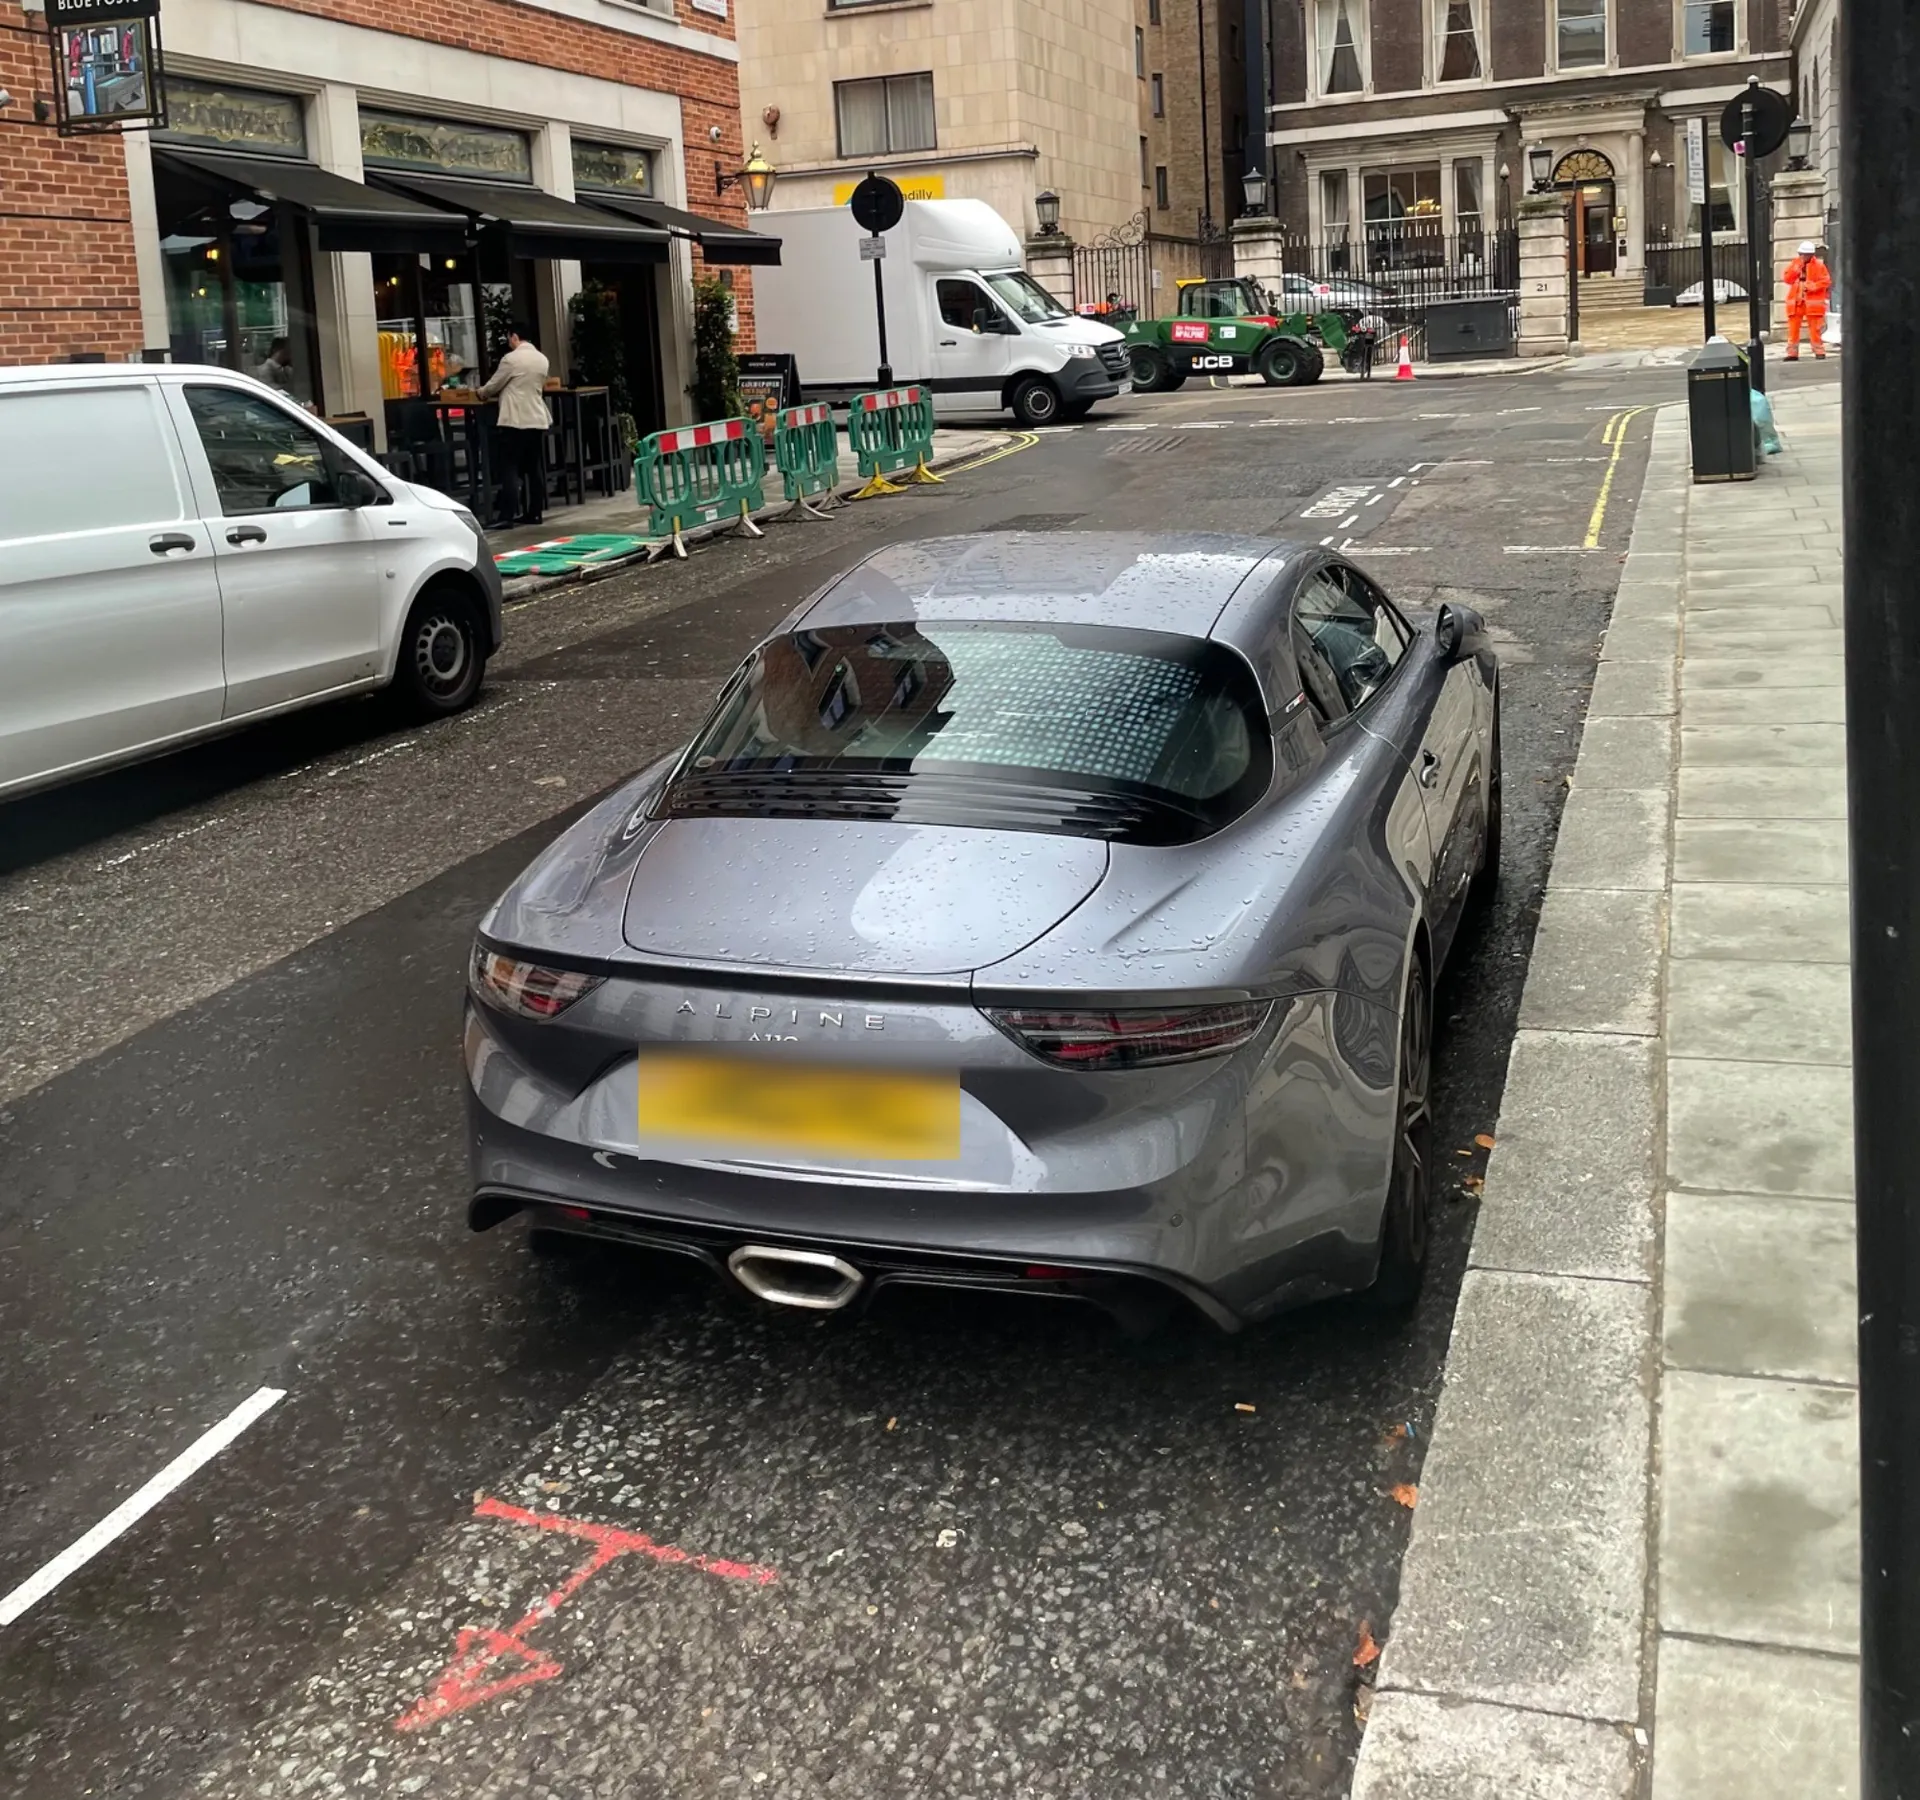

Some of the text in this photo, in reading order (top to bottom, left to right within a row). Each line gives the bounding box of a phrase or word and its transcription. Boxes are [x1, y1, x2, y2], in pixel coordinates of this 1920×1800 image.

[1536, 283, 1548, 292] 21
[1192, 355, 1234, 369] JCB
[676, 1000, 885, 1031] ALPINE
